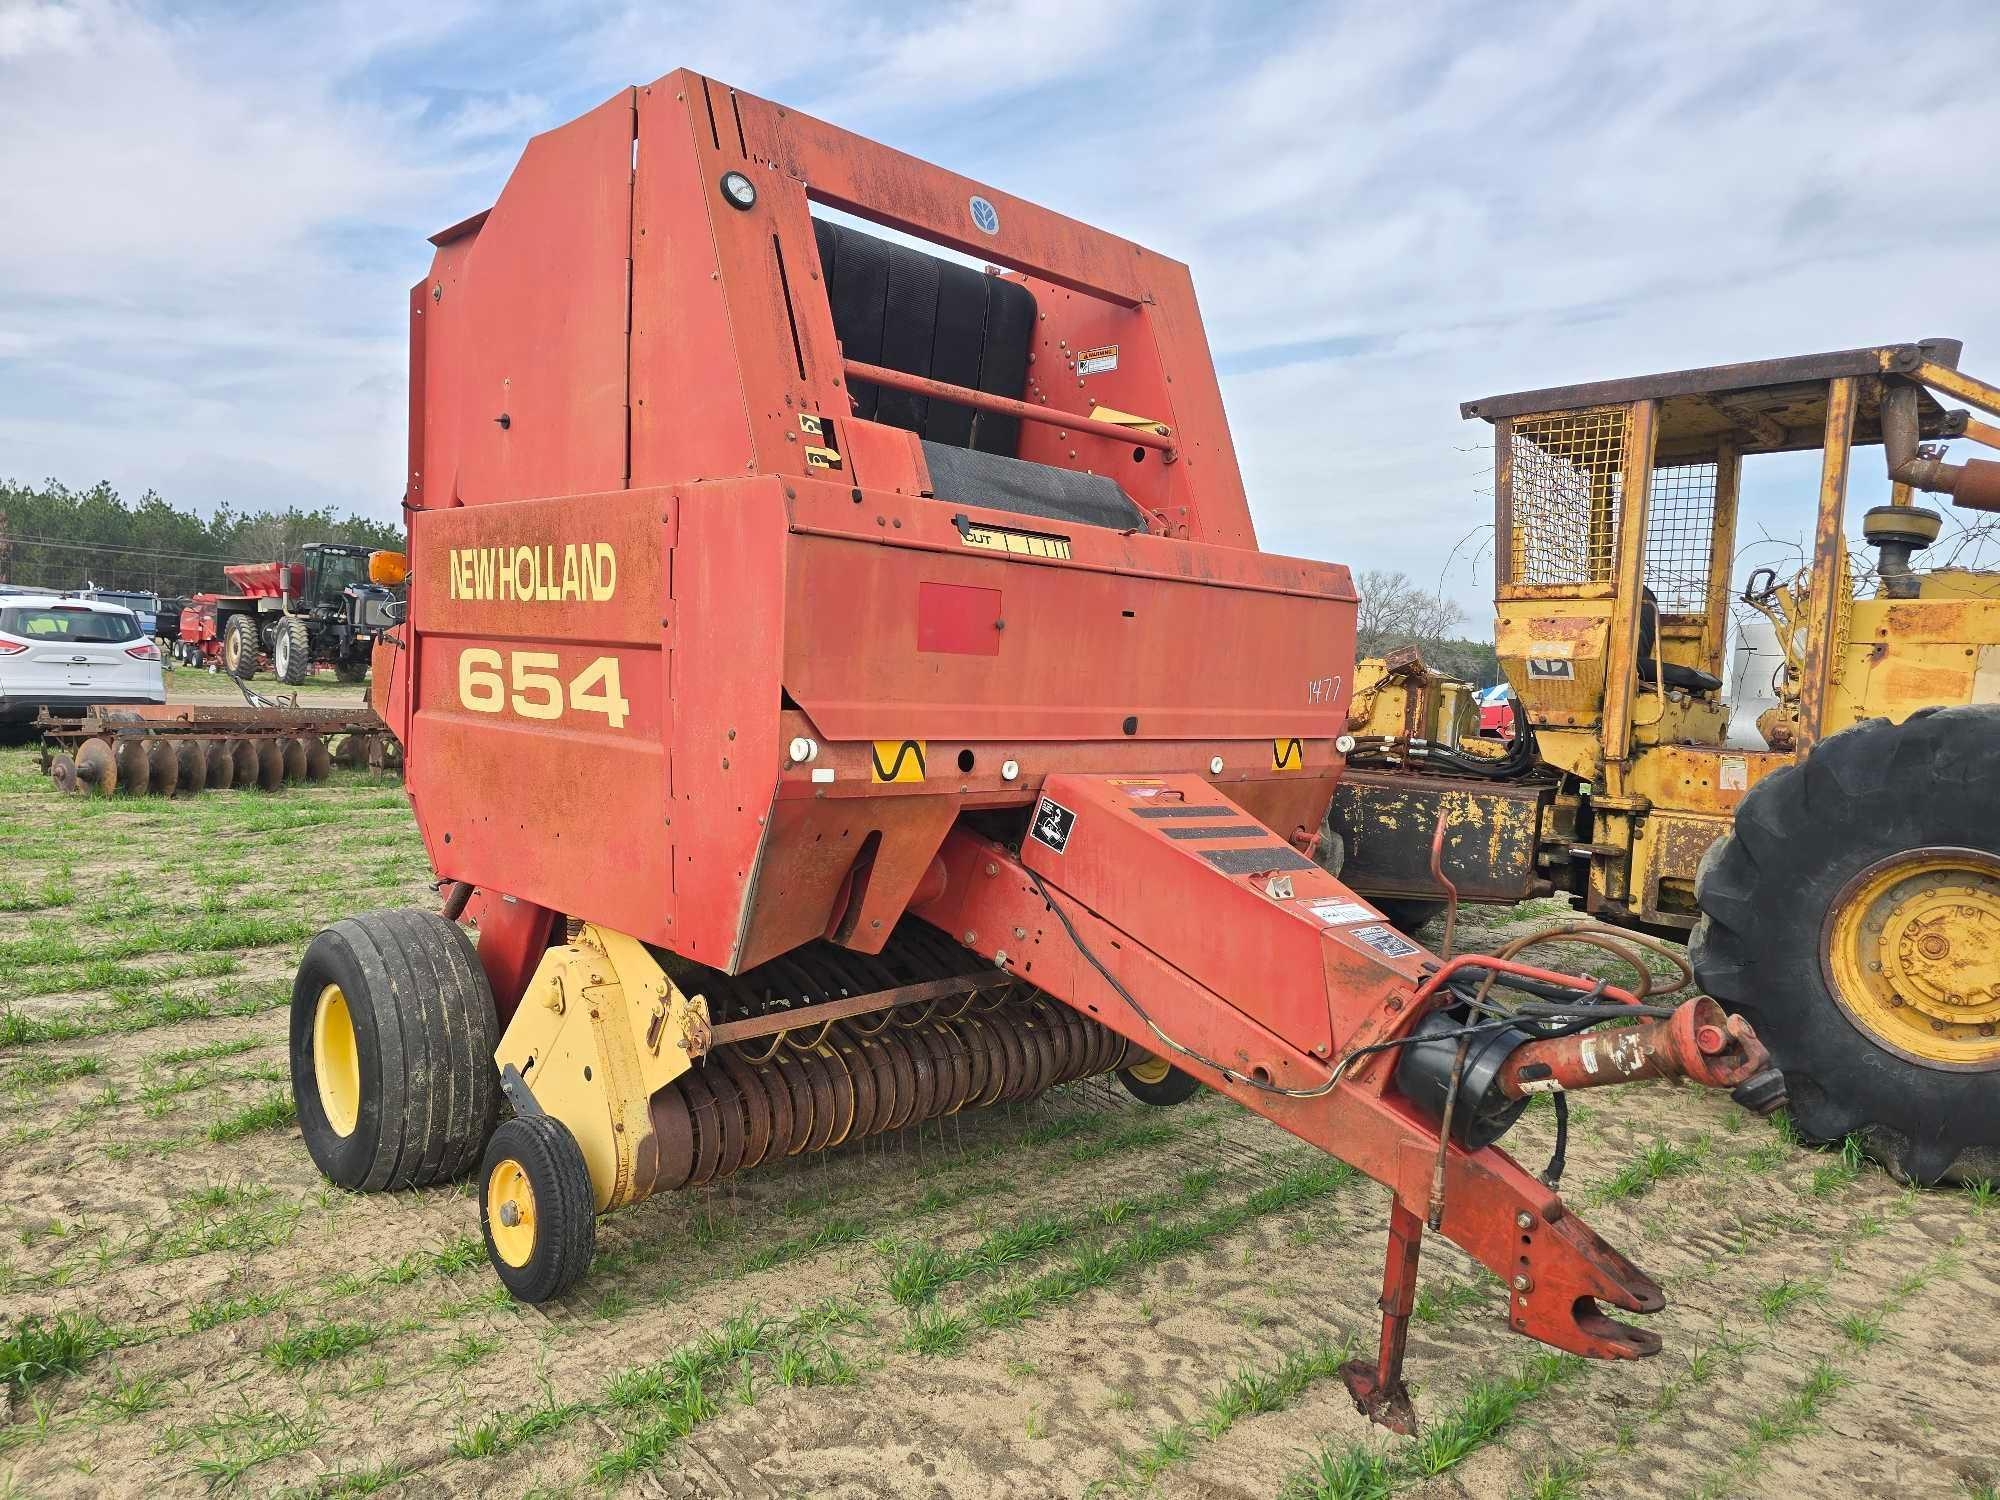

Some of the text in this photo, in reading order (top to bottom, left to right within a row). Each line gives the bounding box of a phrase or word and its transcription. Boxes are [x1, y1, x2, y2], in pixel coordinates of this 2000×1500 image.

[966, 533, 992, 545] CUT
[449, 542, 617, 601] NEW HOLLAND
[459, 648, 630, 728] 654
[1308, 675, 1341, 704] 1477
